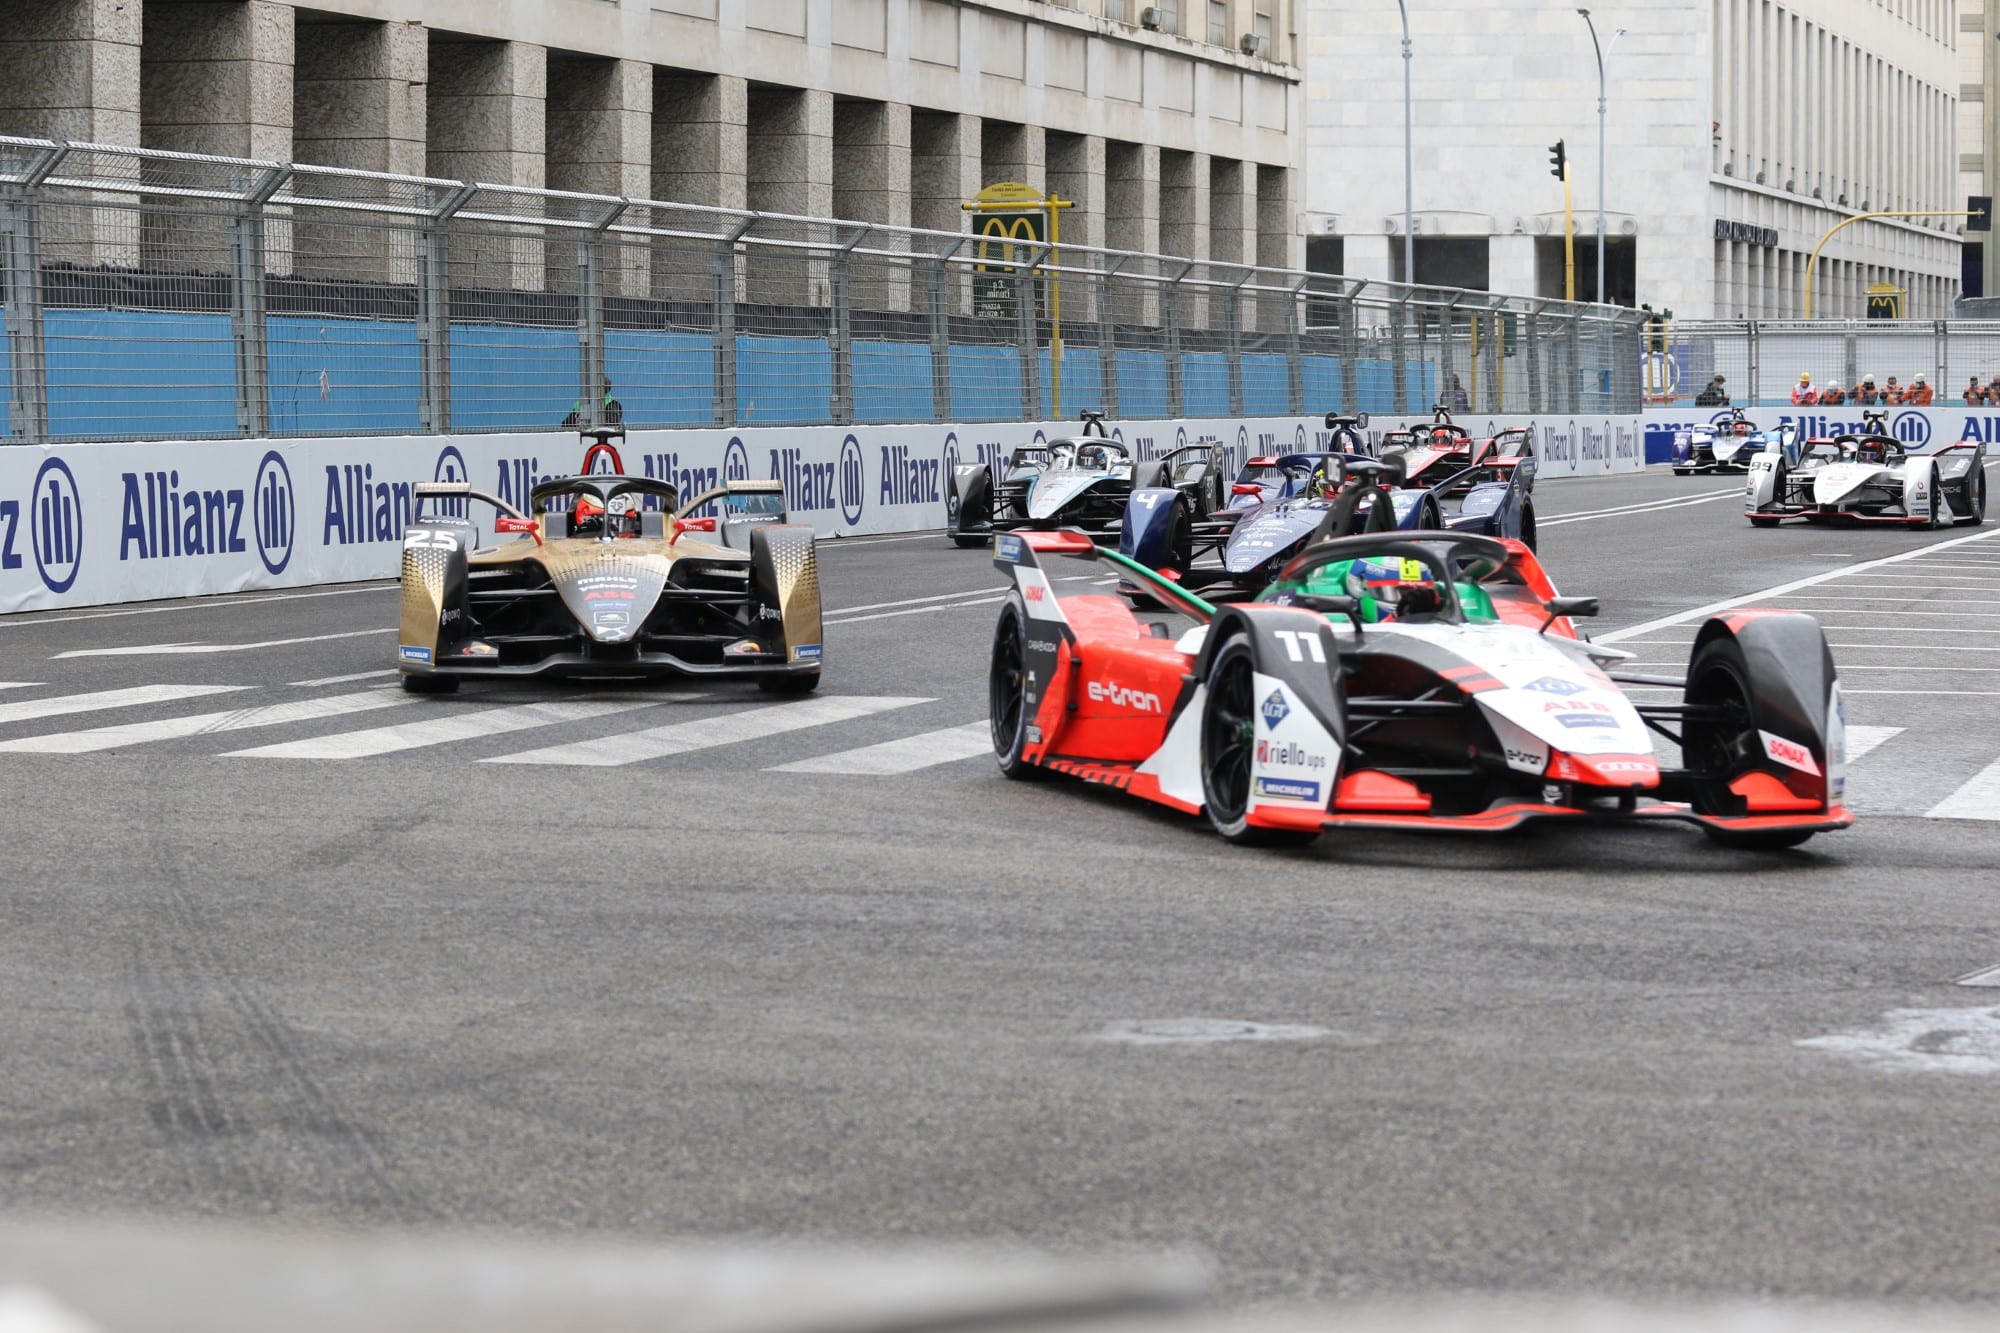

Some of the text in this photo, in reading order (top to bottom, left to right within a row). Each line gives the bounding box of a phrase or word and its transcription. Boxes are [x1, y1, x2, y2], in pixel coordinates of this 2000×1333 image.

[1778, 415, 1871, 440] Allian
[1544, 427, 1568, 461] Allianz
[1582, 426, 1603, 460] Allianz
[770, 448, 836, 511] Allianz
[880, 445, 939, 506] Allianz
[956, 465, 977, 475] 17
[1750, 461, 1773, 472] 99
[120, 470, 246, 560] Allianz
[1137, 494, 1158, 509] 4
[404, 530, 457, 551] 25
[508, 523, 530, 531] TOTAL
[684, 523, 704, 531] TOTAL
[1274, 630, 1327, 663] 11
[1088, 680, 1161, 713] e-tron
[1270, 742, 1325, 772] riello ups
[1769, 739, 1806, 766] SONAX
[1266, 782, 1315, 796] MICHELIN
